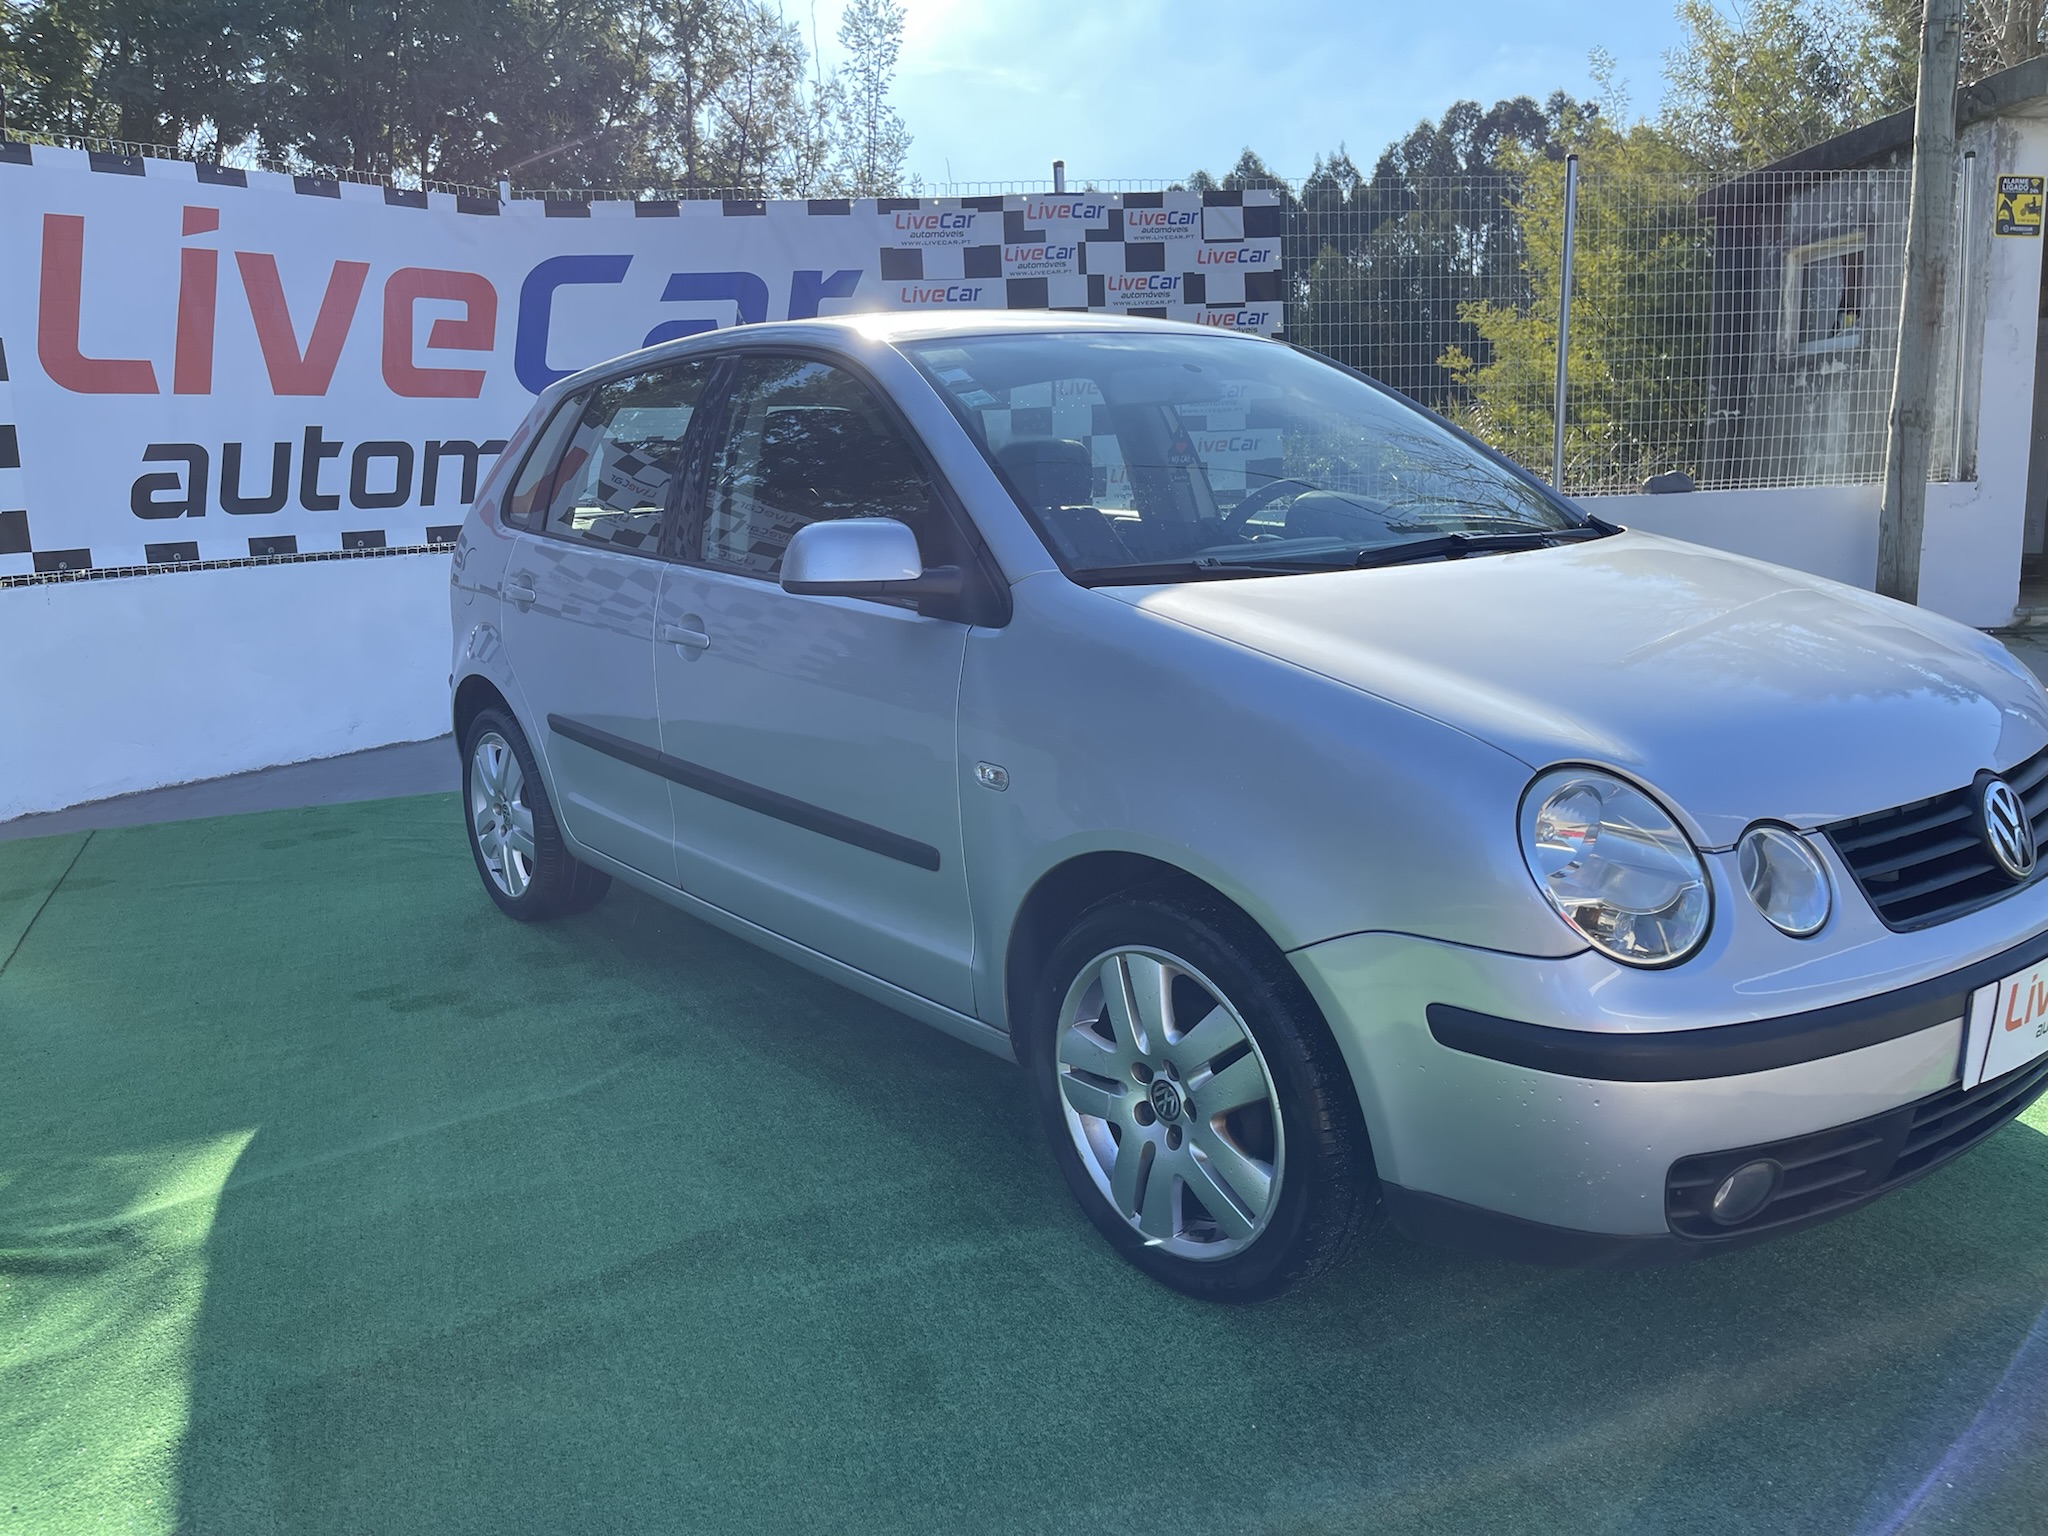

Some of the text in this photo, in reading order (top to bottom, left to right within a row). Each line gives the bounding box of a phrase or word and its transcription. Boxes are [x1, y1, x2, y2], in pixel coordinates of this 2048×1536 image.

[1026, 202, 1105, 220] LiveCar
[1129, 211, 1199, 226] LiveCar
[895, 213, 976, 230] LiveCar
[909, 230, 964, 239] automóveis
[1141, 226, 1188, 234] automóveis
[1004, 246, 1076, 262] LiveCar
[1197, 249, 1271, 265] LiveCar
[1017, 261, 1067, 269] automóveis
[1107, 275, 1181, 291] LiveCar
[38, 205, 864, 398] LiveCar
[901, 286, 982, 303] LiveCar
[1120, 291, 1171, 299] automóveis
[1196, 311, 1269, 327] LiveCar
[1198, 437, 1262, 453] iveCar
